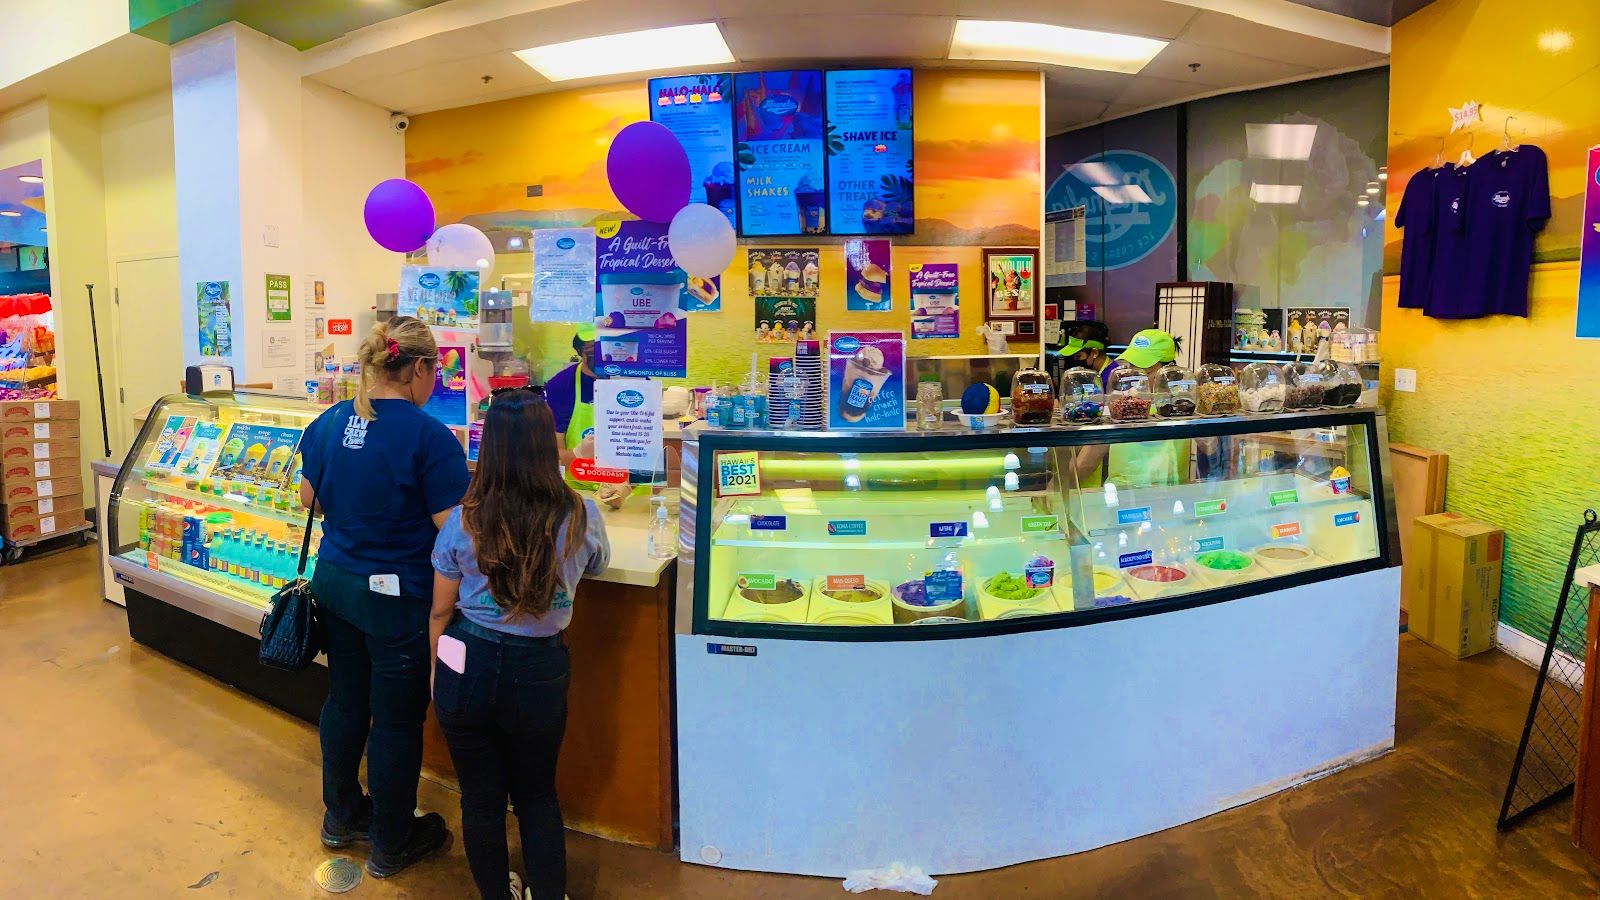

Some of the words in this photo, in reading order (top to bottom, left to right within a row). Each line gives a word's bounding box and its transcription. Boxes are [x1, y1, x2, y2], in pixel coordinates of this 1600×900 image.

[843, 131, 877, 141] SHAVE
[881, 131, 898, 140] ICE
[752, 144, 769, 154] ICE
[772, 143, 810, 154] CREAM
[746, 176, 772, 185] MILK
[838, 181, 875, 190] OTHER
[748, 187, 789, 197] SHAKES
[838, 192, 879, 200] TREATS
[600, 224, 616, 234] NEW!
[608, 236, 620, 252] A
[599, 252, 640, 271] Tropical
[632, 299, 652, 307] UBE
[722, 464, 755, 476] BEST
[729, 475, 756, 486] 2021
